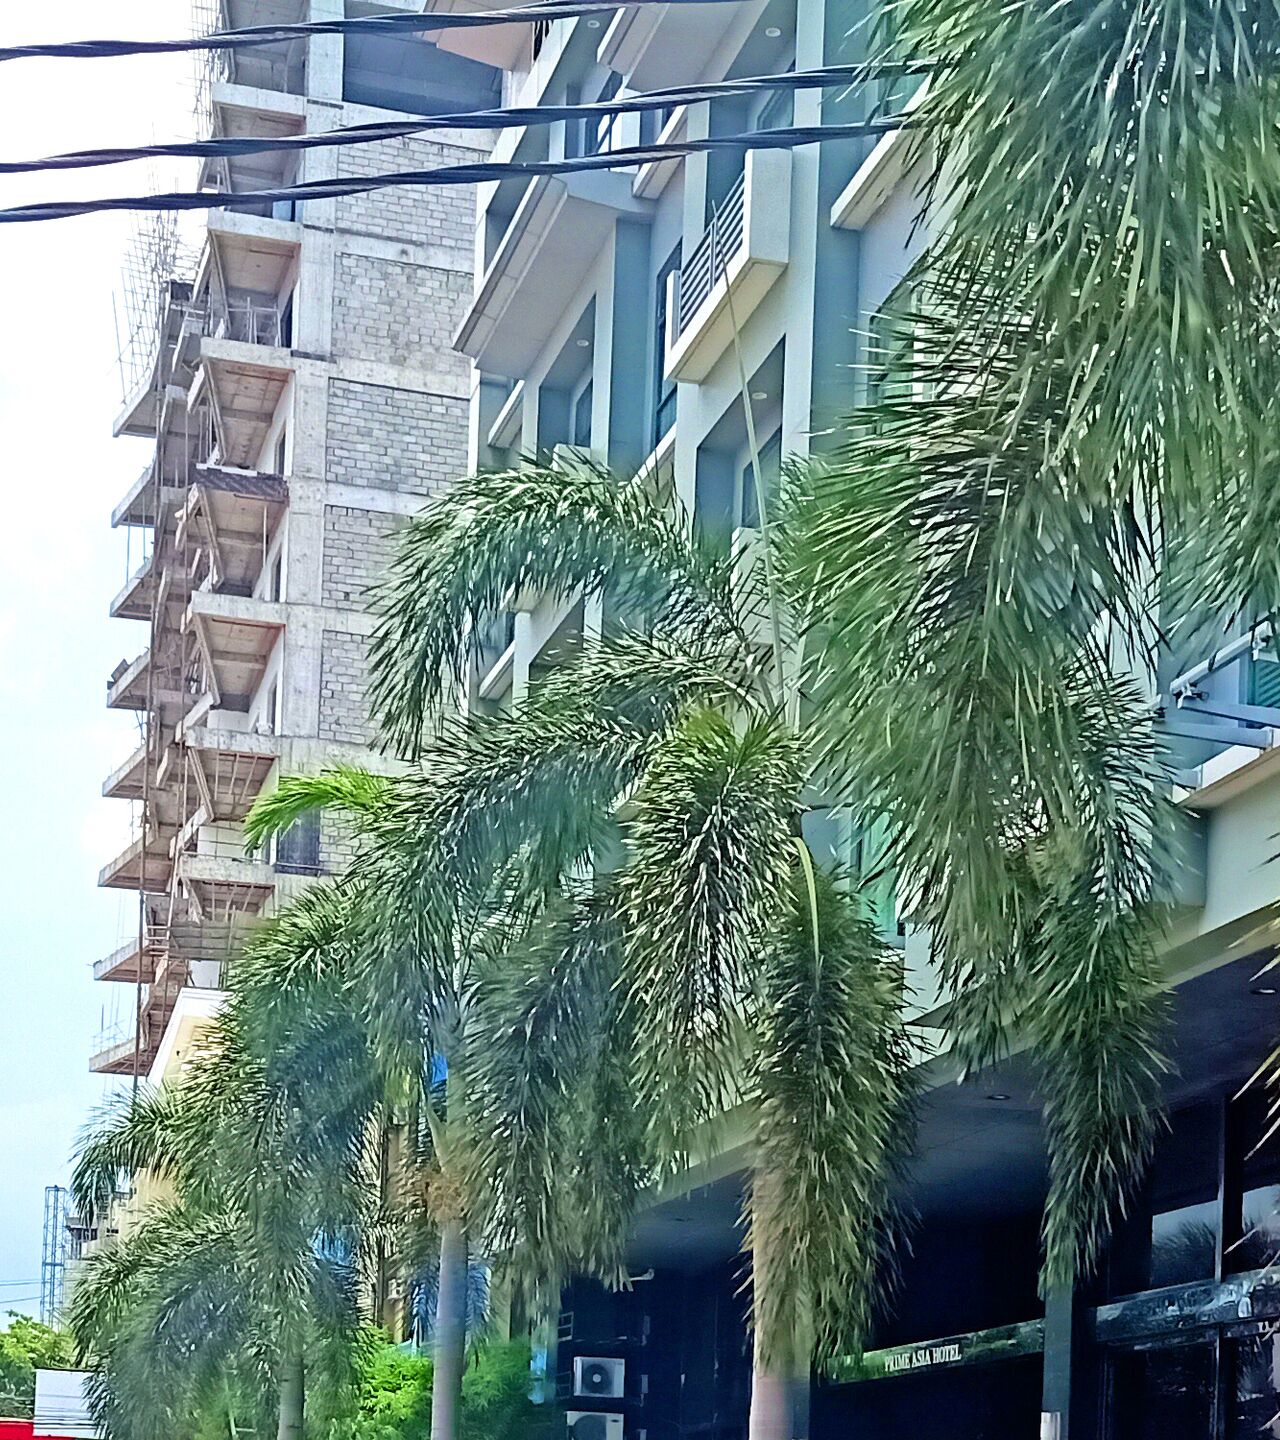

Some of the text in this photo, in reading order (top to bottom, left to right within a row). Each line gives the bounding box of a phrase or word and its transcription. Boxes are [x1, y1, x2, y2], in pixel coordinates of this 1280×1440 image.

[884, 1343, 962, 1372] PRIME ASIA HOTEL
